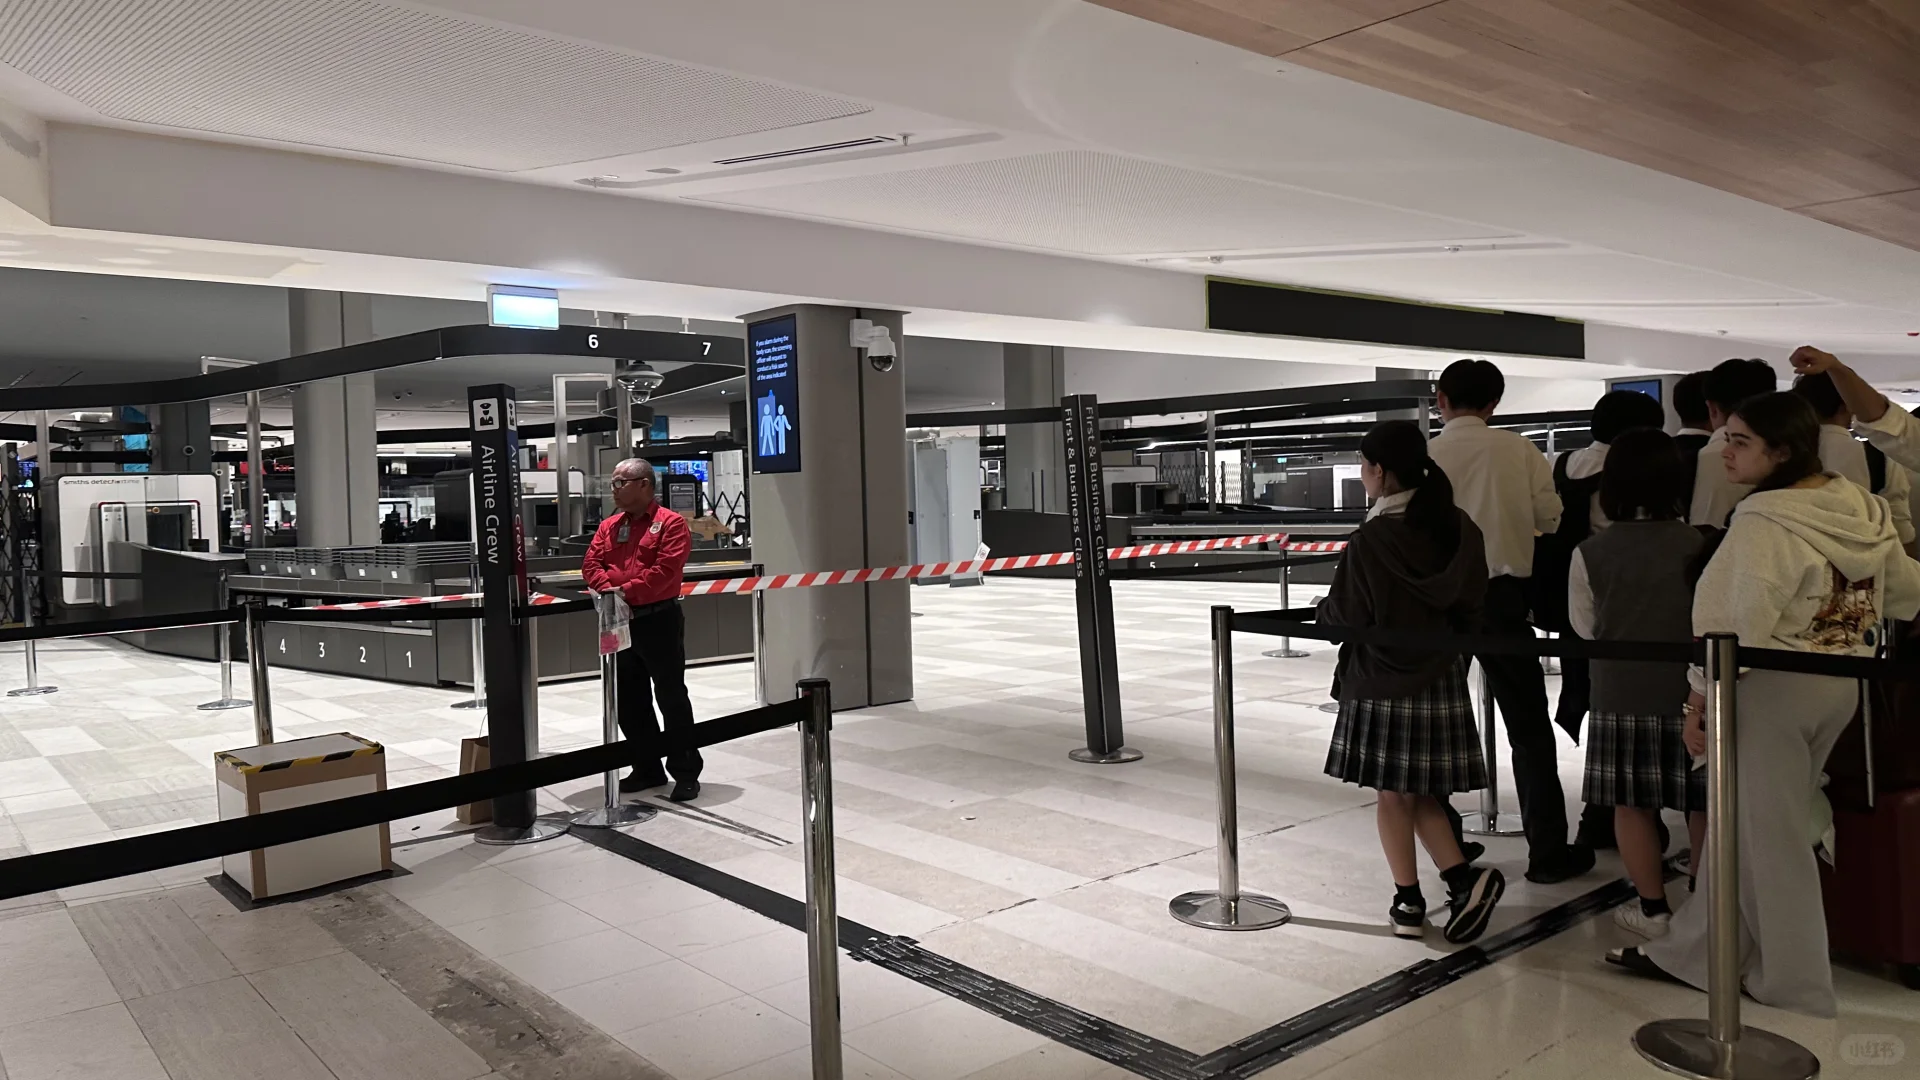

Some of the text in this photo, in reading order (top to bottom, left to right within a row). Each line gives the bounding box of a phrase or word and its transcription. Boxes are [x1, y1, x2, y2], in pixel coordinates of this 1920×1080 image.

[588, 334, 599, 349] 6
[702, 341, 712, 356] 7
[481, 444, 500, 564] Airline Crew
[510, 444, 523, 562] Airline Crew
[1064, 408, 1084, 578] First & Business Class
[1086, 407, 1106, 577] First & Business Class
[279, 638, 412, 668] 4 3 2 1
